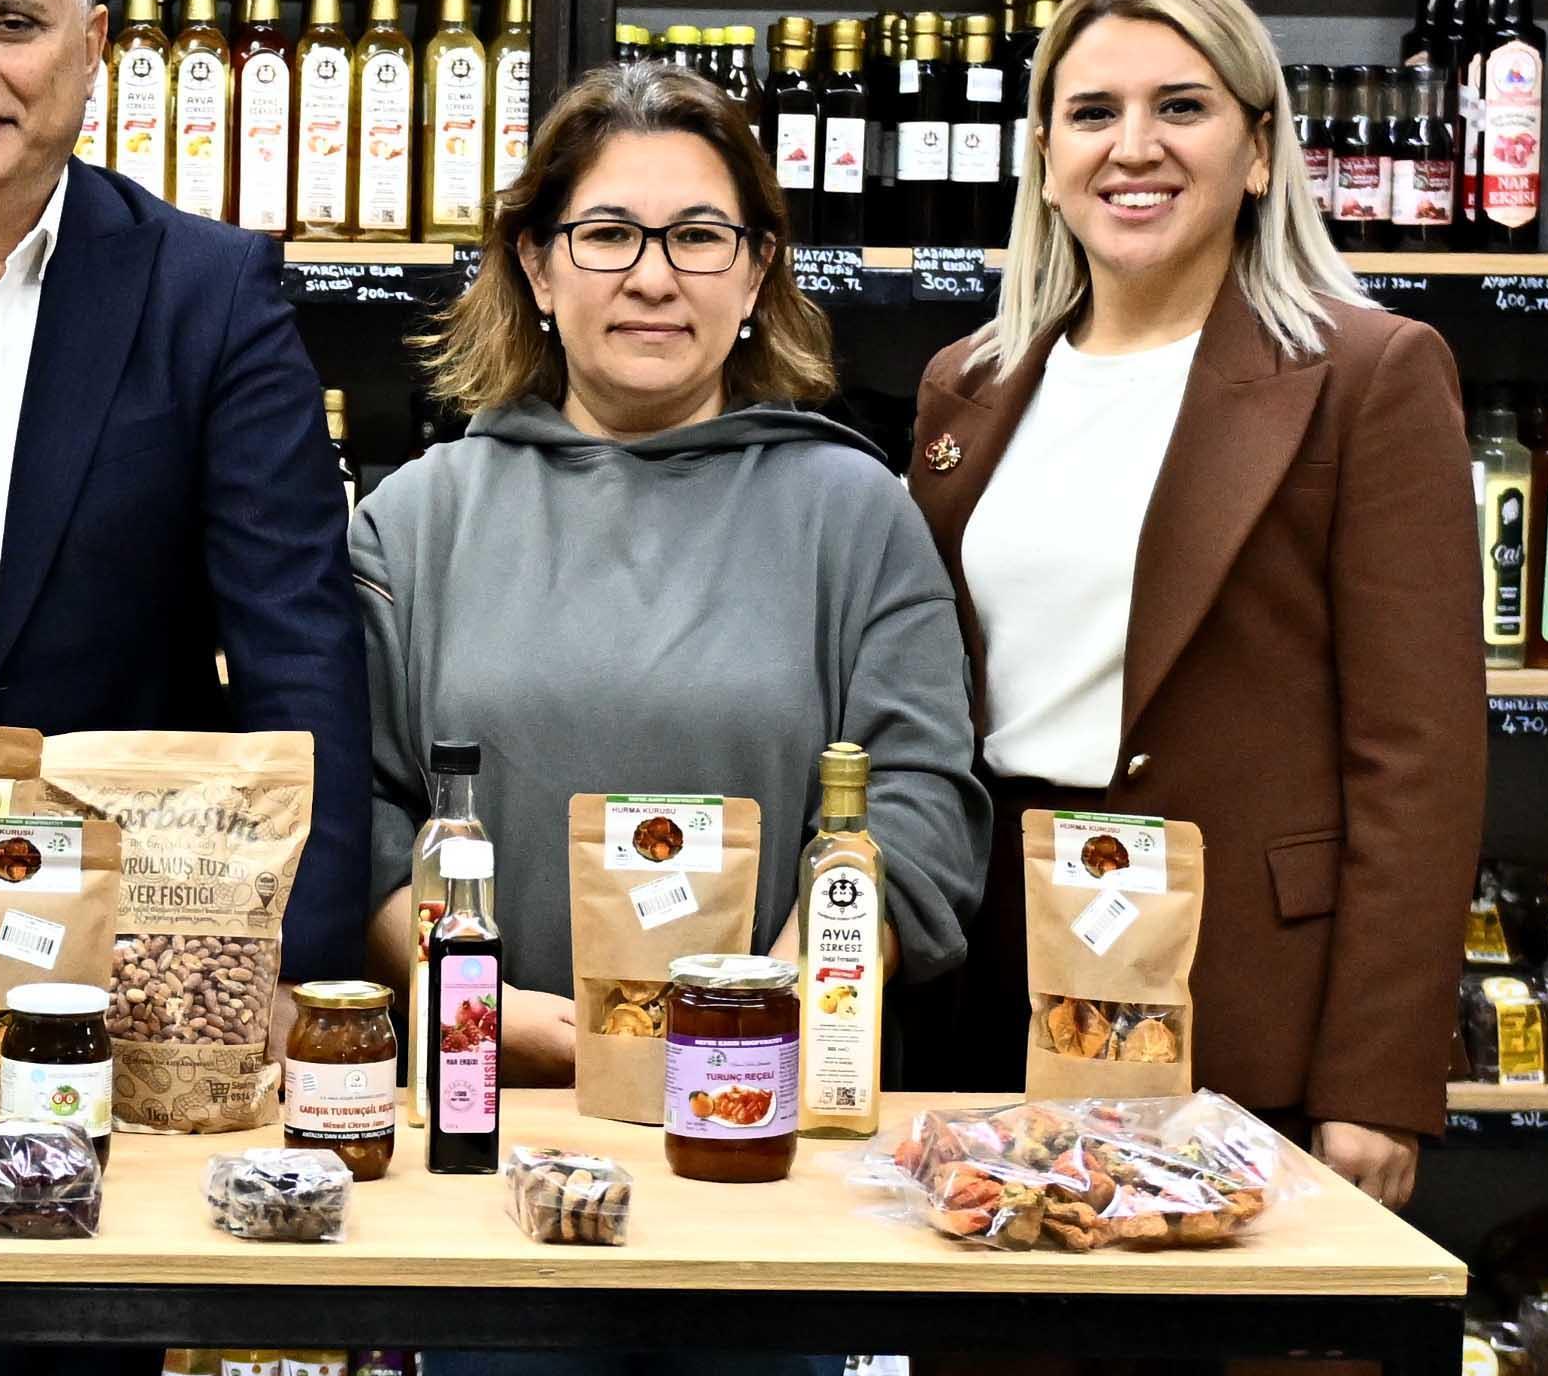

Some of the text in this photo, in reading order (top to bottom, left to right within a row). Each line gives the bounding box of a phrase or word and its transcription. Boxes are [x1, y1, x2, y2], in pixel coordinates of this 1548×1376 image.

[454, 251, 480, 261] ELM
[794, 248, 834, 262] HATAY
[843, 278, 864, 291] TL
[128, 883, 155, 905] YER
[821, 928, 862, 941] AYVA
[705, 1072, 744, 1083] TURUNÇ
